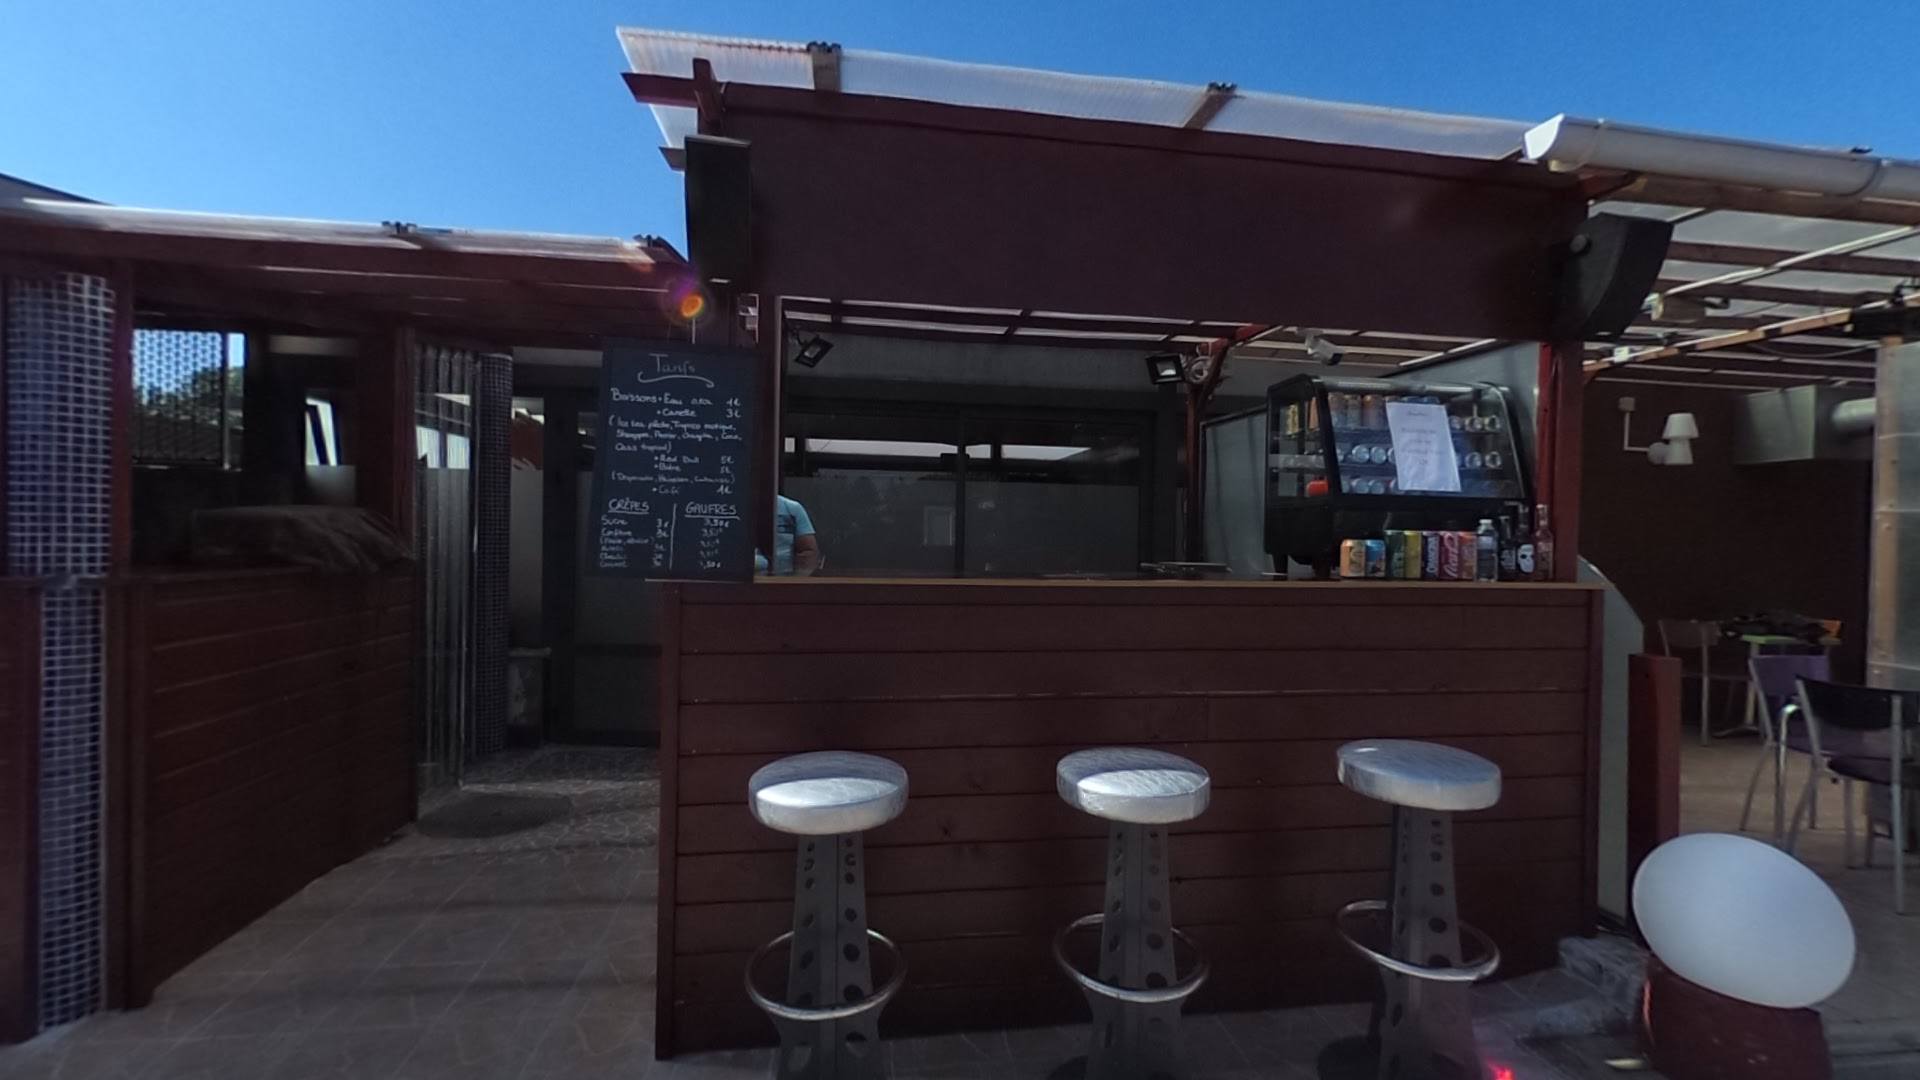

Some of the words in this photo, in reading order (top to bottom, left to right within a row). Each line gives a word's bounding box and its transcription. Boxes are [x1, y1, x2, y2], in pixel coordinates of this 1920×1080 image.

[649, 353, 696, 376] Tarifs
[610, 387, 657, 402] Boissons
[664, 393, 683, 405] Eau
[685, 502, 737, 515] GAUFRES
